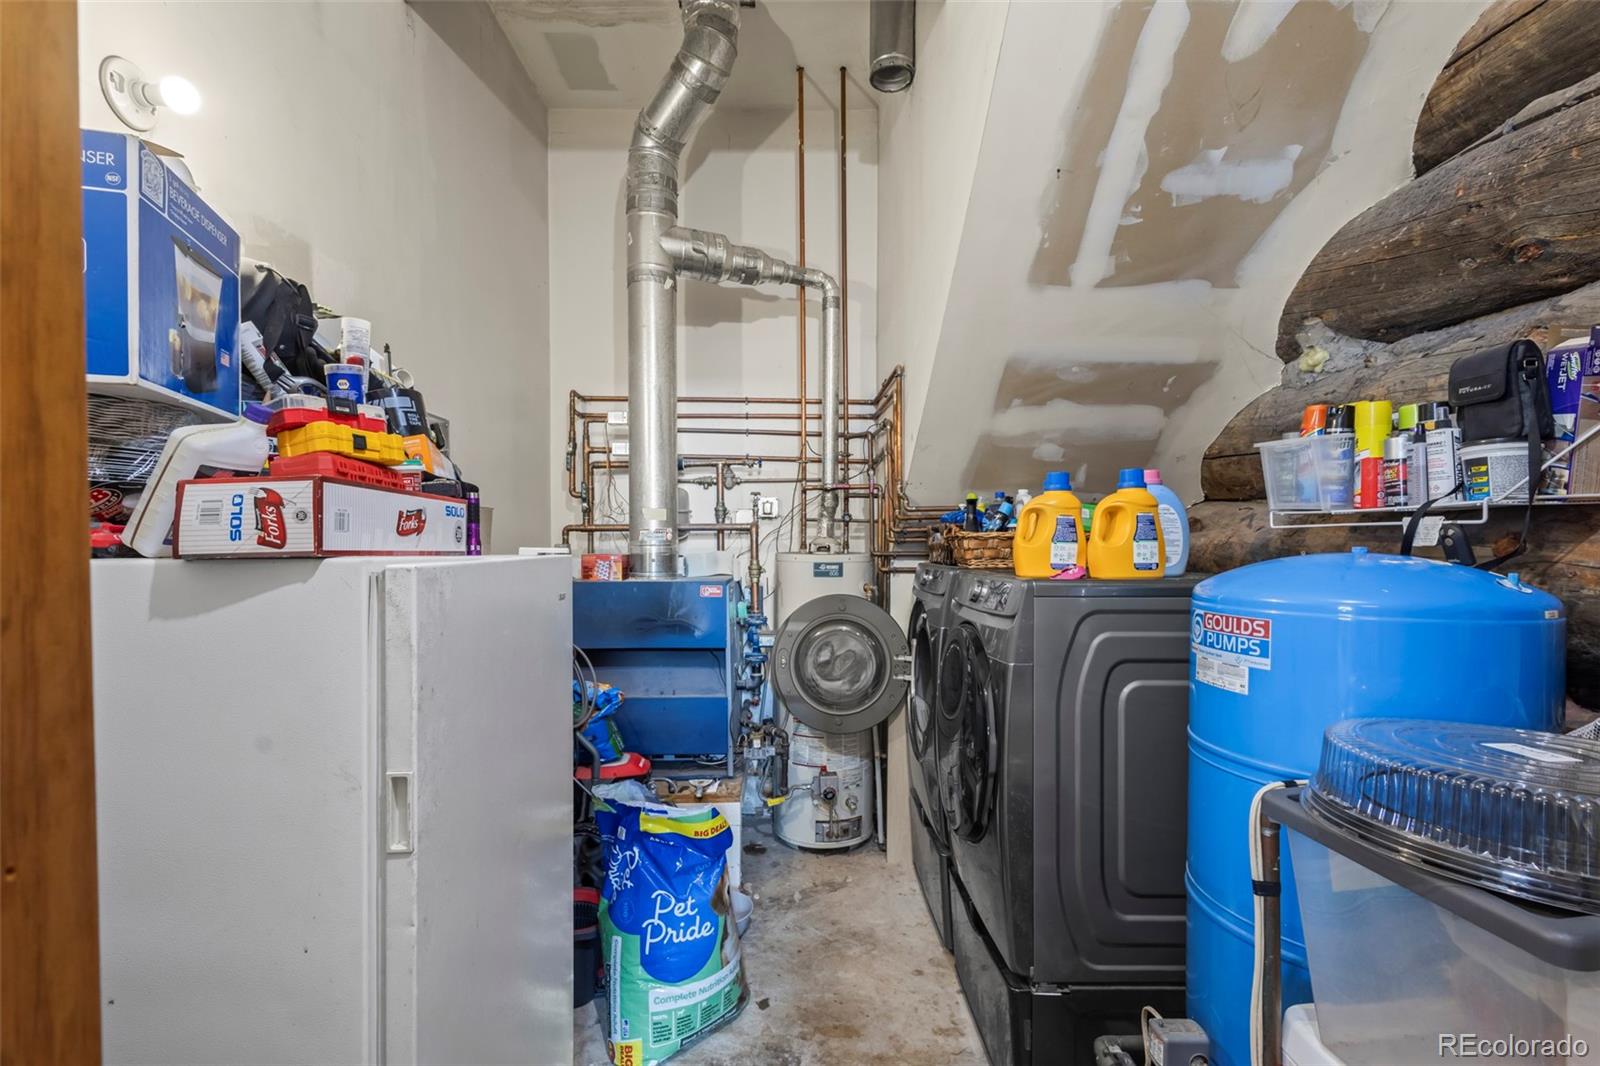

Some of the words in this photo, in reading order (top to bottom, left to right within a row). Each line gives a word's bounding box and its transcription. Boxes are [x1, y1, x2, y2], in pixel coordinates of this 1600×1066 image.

[169, 186, 200, 222] BEVERAGE
[200, 215, 227, 246] DISPENSER
[1557, 352, 1569, 390] WETJET
[230, 494, 244, 542] SOLO
[445, 505, 464, 518] SOLO
[265, 504, 281, 545] Forks
[399, 517, 419, 531] Forks
[1205, 614, 1265, 637] GOULDS
[1206, 632, 1261, 656] PUMPS
[694, 828, 709, 838] BIG
[651, 889, 698, 926] Pet
[641, 917, 715, 956] Pride
[653, 990, 697, 1005] Complete
[623, 1046, 632, 1066] BIG
